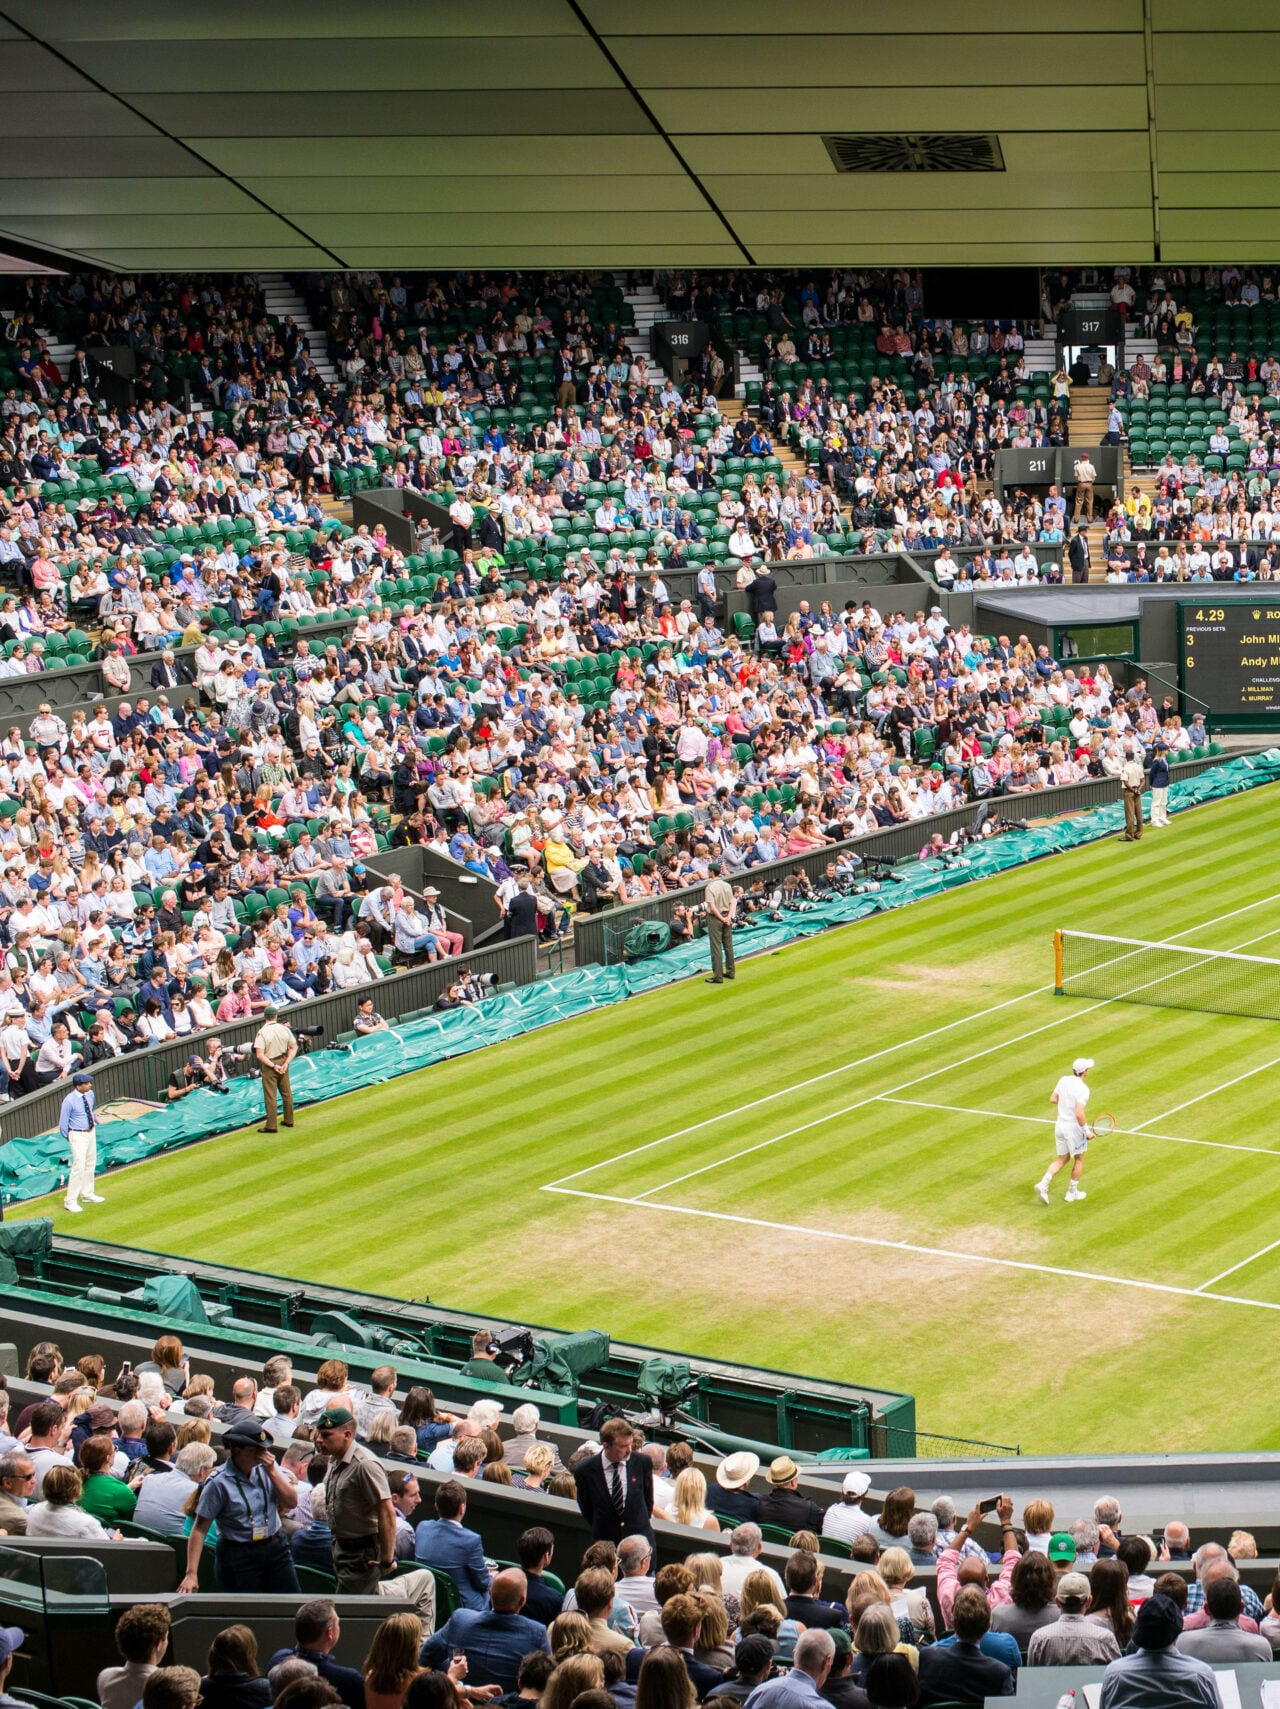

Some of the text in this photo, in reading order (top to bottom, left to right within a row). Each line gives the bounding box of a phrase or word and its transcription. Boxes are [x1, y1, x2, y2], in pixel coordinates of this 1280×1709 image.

[1082, 322, 1100, 332] 317
[671, 334, 689, 345] 316
[1029, 460, 1046, 472] 211
[1195, 609, 1225, 621] 4.29
[1186, 634, 1194, 646] 3
[1240, 635, 1266, 644] John
[1186, 657, 1195, 668] 6
[1241, 657, 1267, 668] Andy
